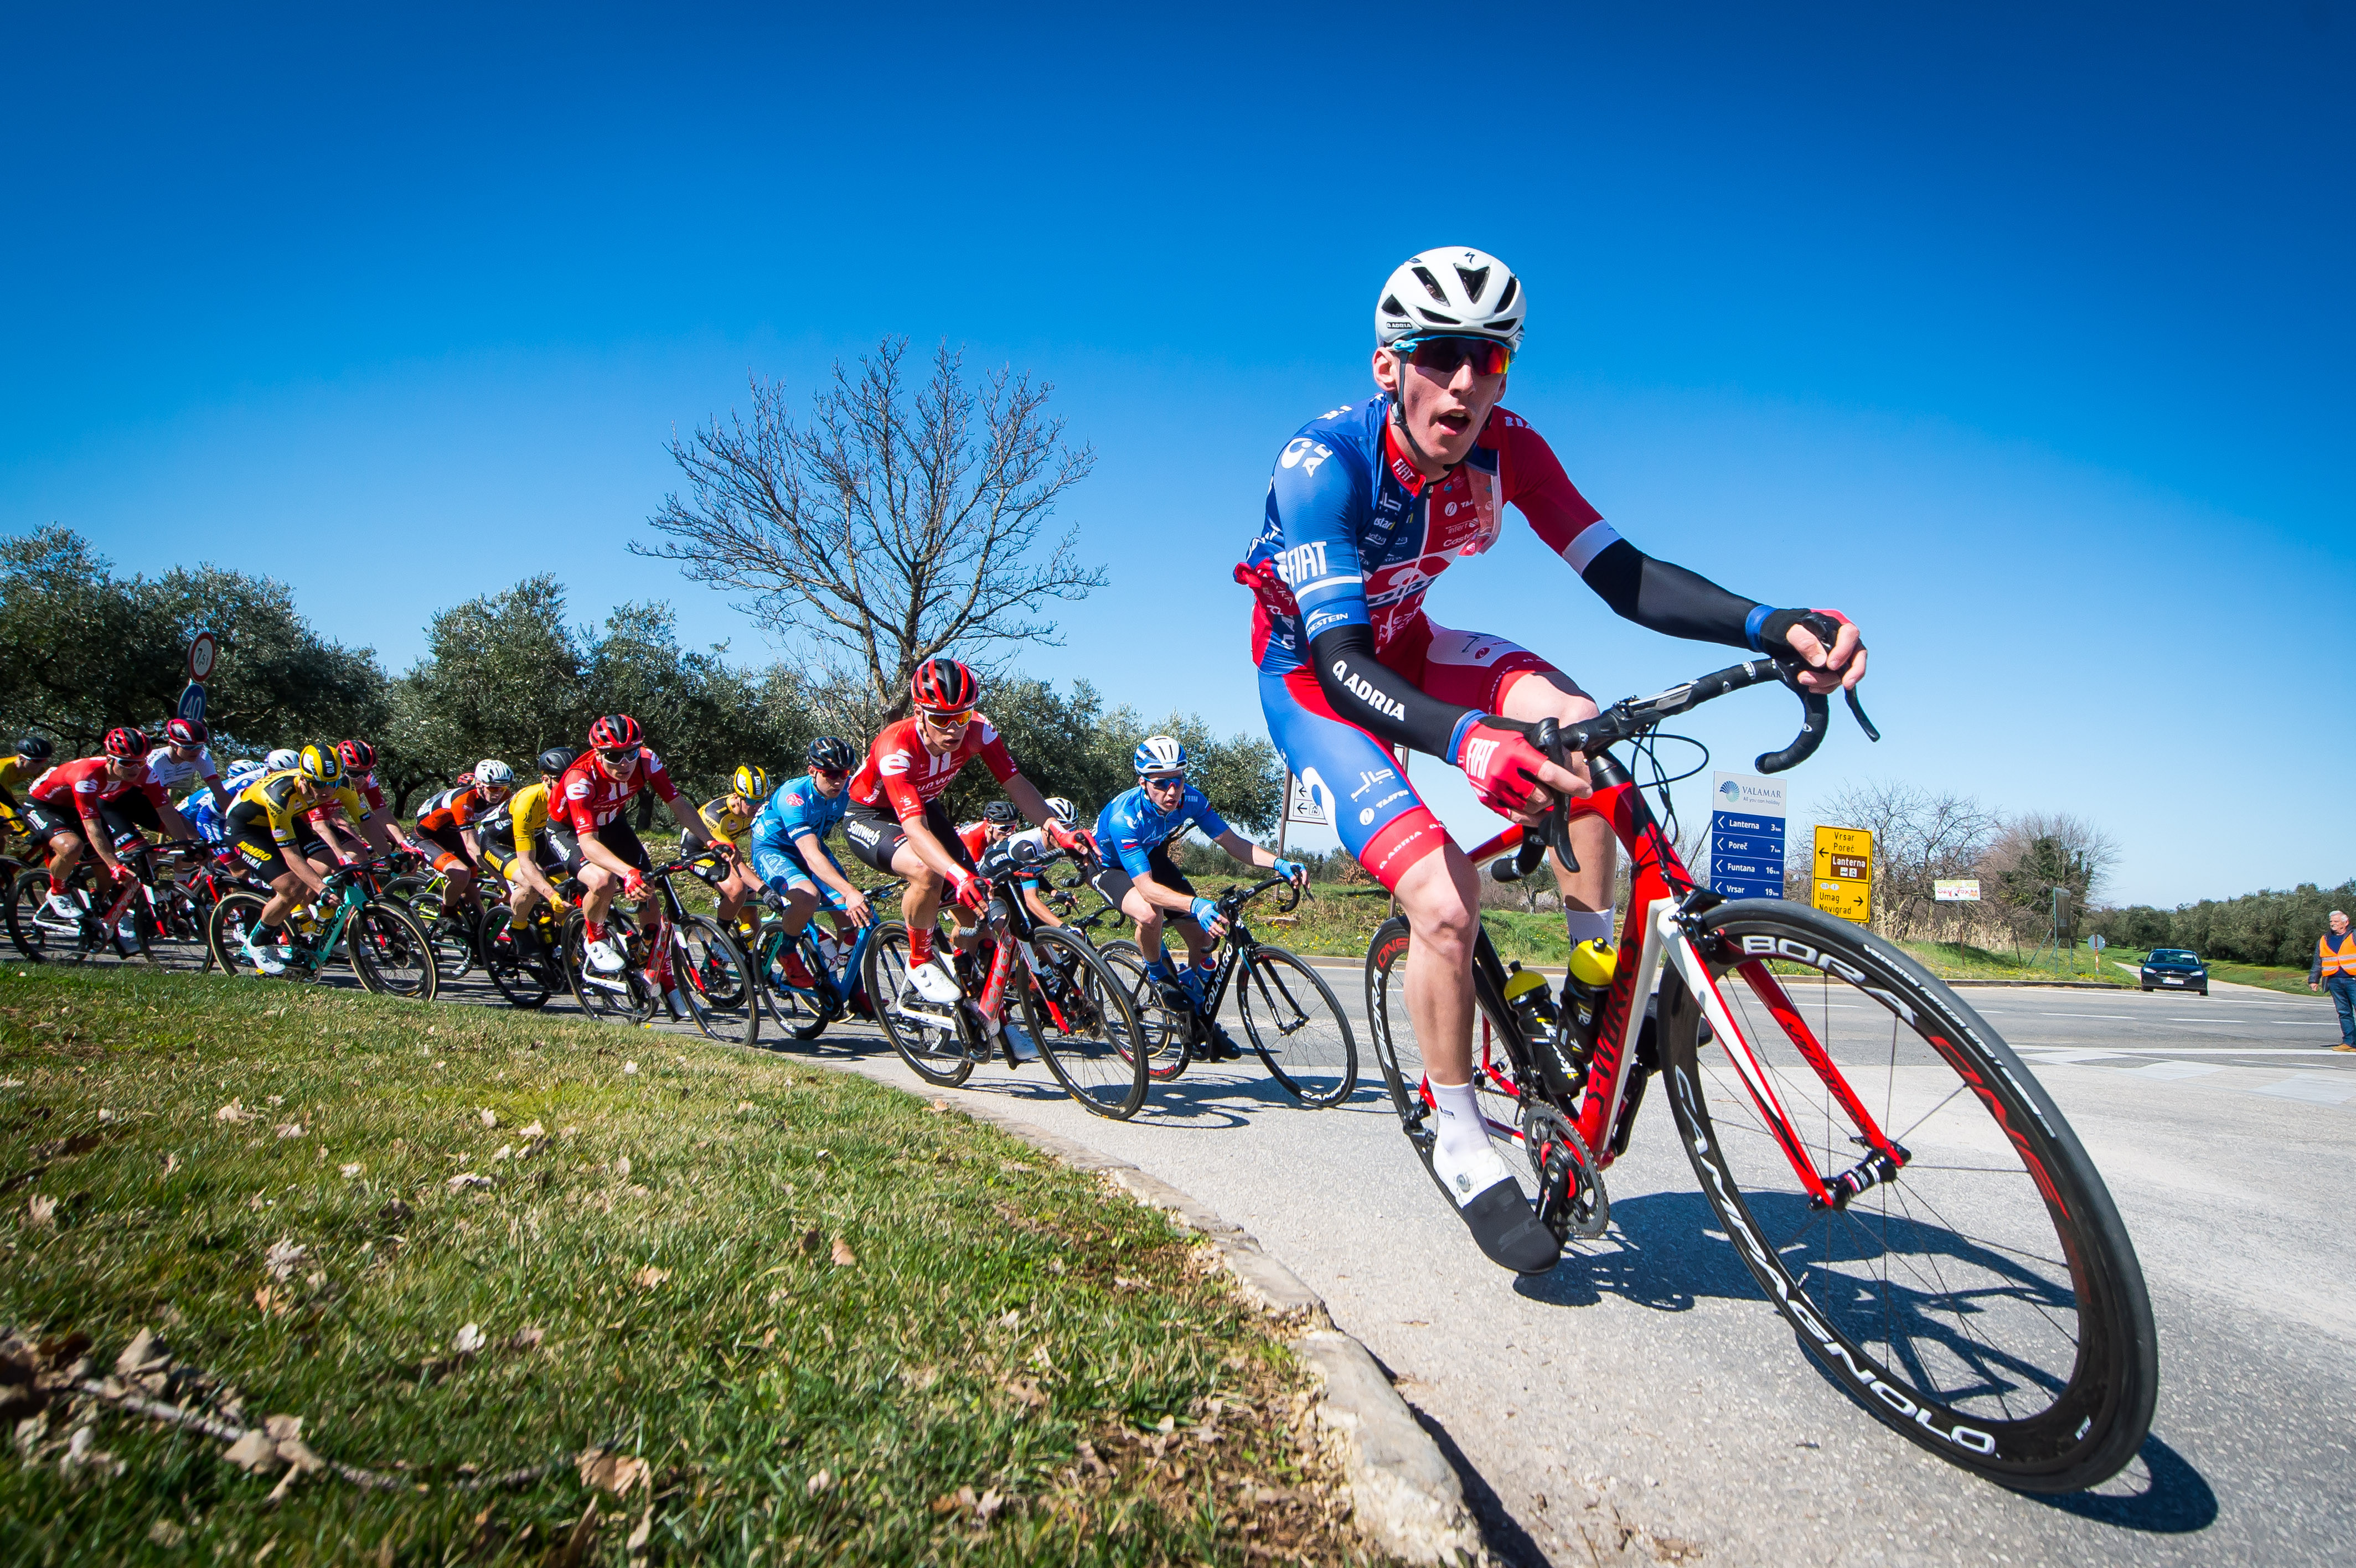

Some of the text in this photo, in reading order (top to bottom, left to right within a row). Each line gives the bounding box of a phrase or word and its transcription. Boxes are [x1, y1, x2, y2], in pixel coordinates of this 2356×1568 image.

[1392, 458, 1416, 481] FIAT
[1288, 541, 1327, 588] FIAT
[184, 695, 202, 720] 40
[1343, 675, 1406, 721] ADRIA
[1466, 738, 1500, 780] FIAT
[1742, 786, 1781, 798] VALAMAR
[848, 820, 881, 846] Sunweb
[1729, 820, 1759, 829] Lanterna
[1387, 831, 1422, 860] ADRIA
[1728, 841, 1748, 850] Poreč
[1834, 831, 1854, 841] Vrsar
[237, 841, 272, 861] JUMBO
[1833, 842, 1854, 852] Poreč
[242, 852, 262, 870] VISMA
[1727, 863, 1755, 872] Funtana
[1832, 856, 1866, 868] Lanterna
[1727, 885, 1744, 894] Vrsar
[1820, 892, 1840, 904] Umag
[1819, 904, 1851, 915] Novigrad
[1378, 938, 1409, 967] ONE
[1742, 935, 1919, 1026] BORA
[1372, 966, 1393, 1069] BORA
[1675, 1065, 1996, 1456] CAMPAGNOLO
